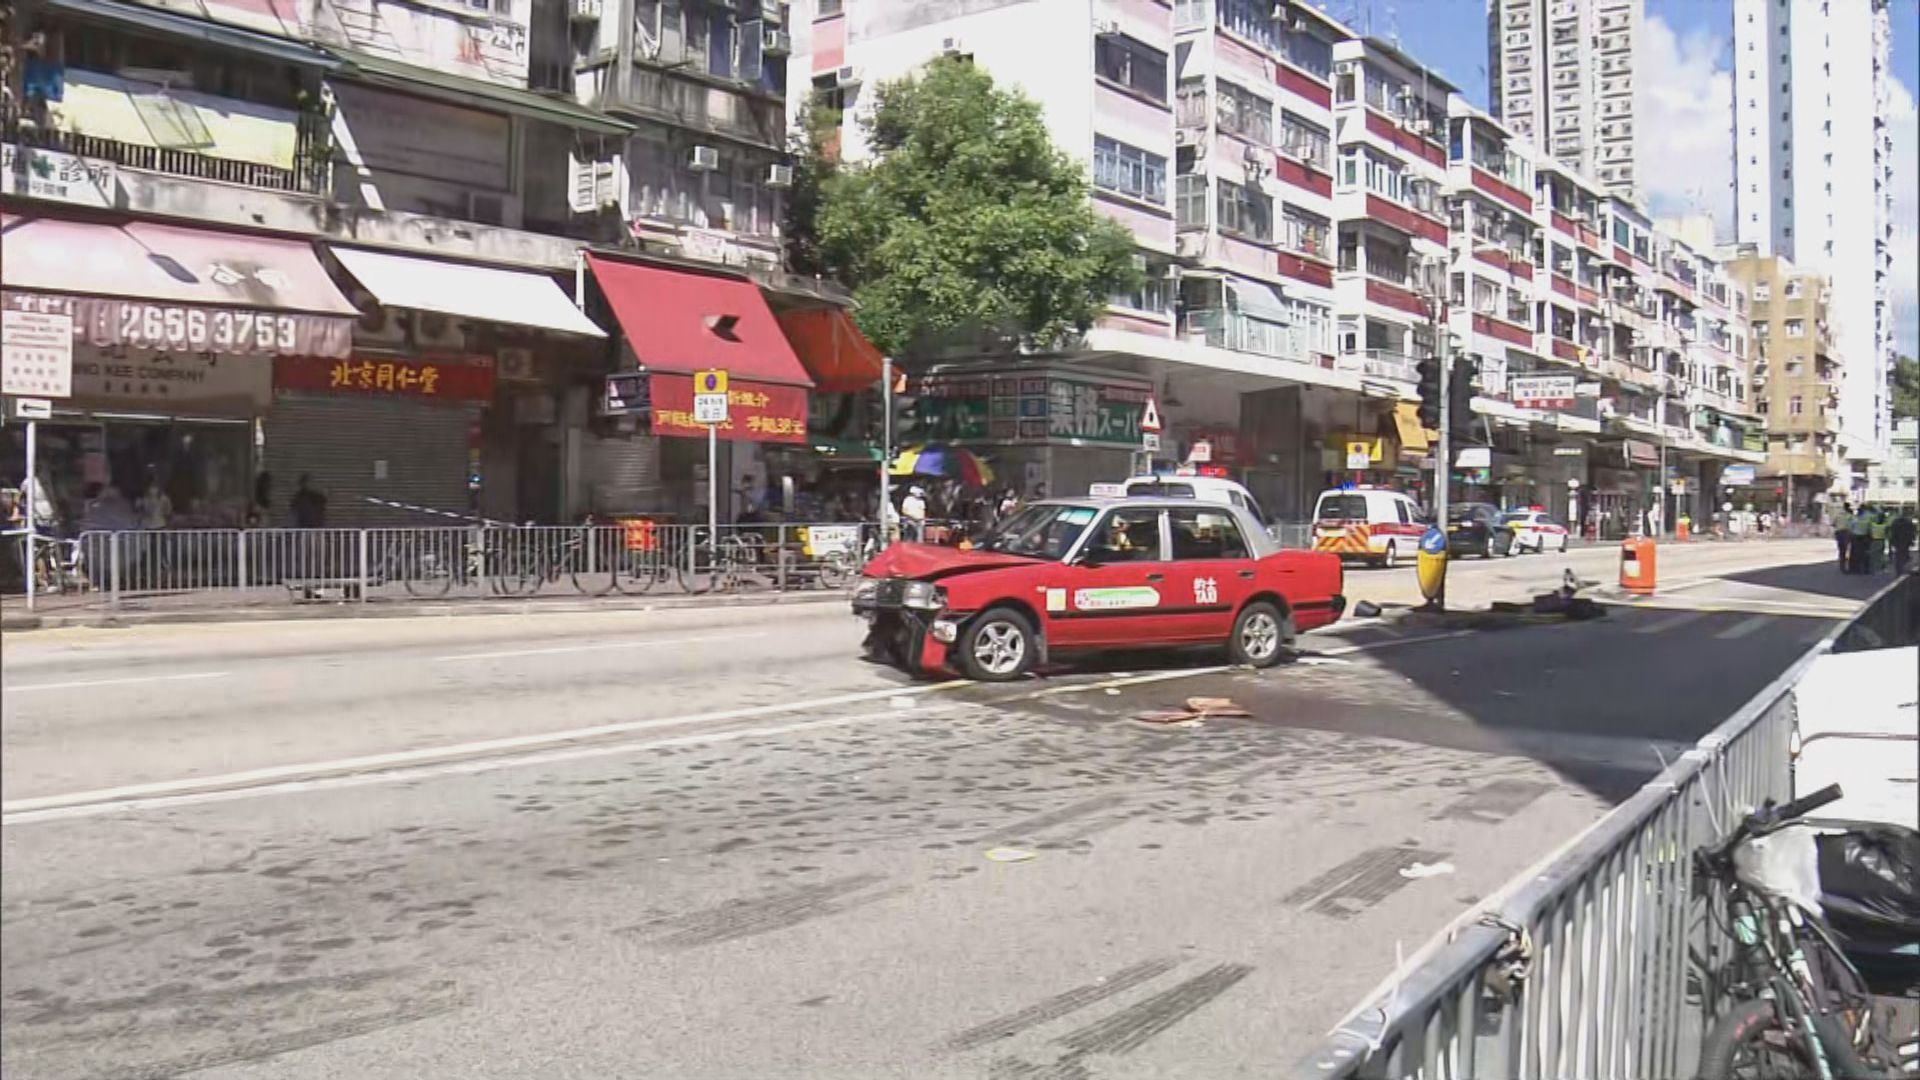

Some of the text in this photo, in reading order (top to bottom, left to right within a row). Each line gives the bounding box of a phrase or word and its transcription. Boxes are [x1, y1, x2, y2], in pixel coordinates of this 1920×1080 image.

[121, 304, 207, 340] 2656
[214, 311, 296, 348] 3753
[331, 361, 439, 393] 北京同仁堂
